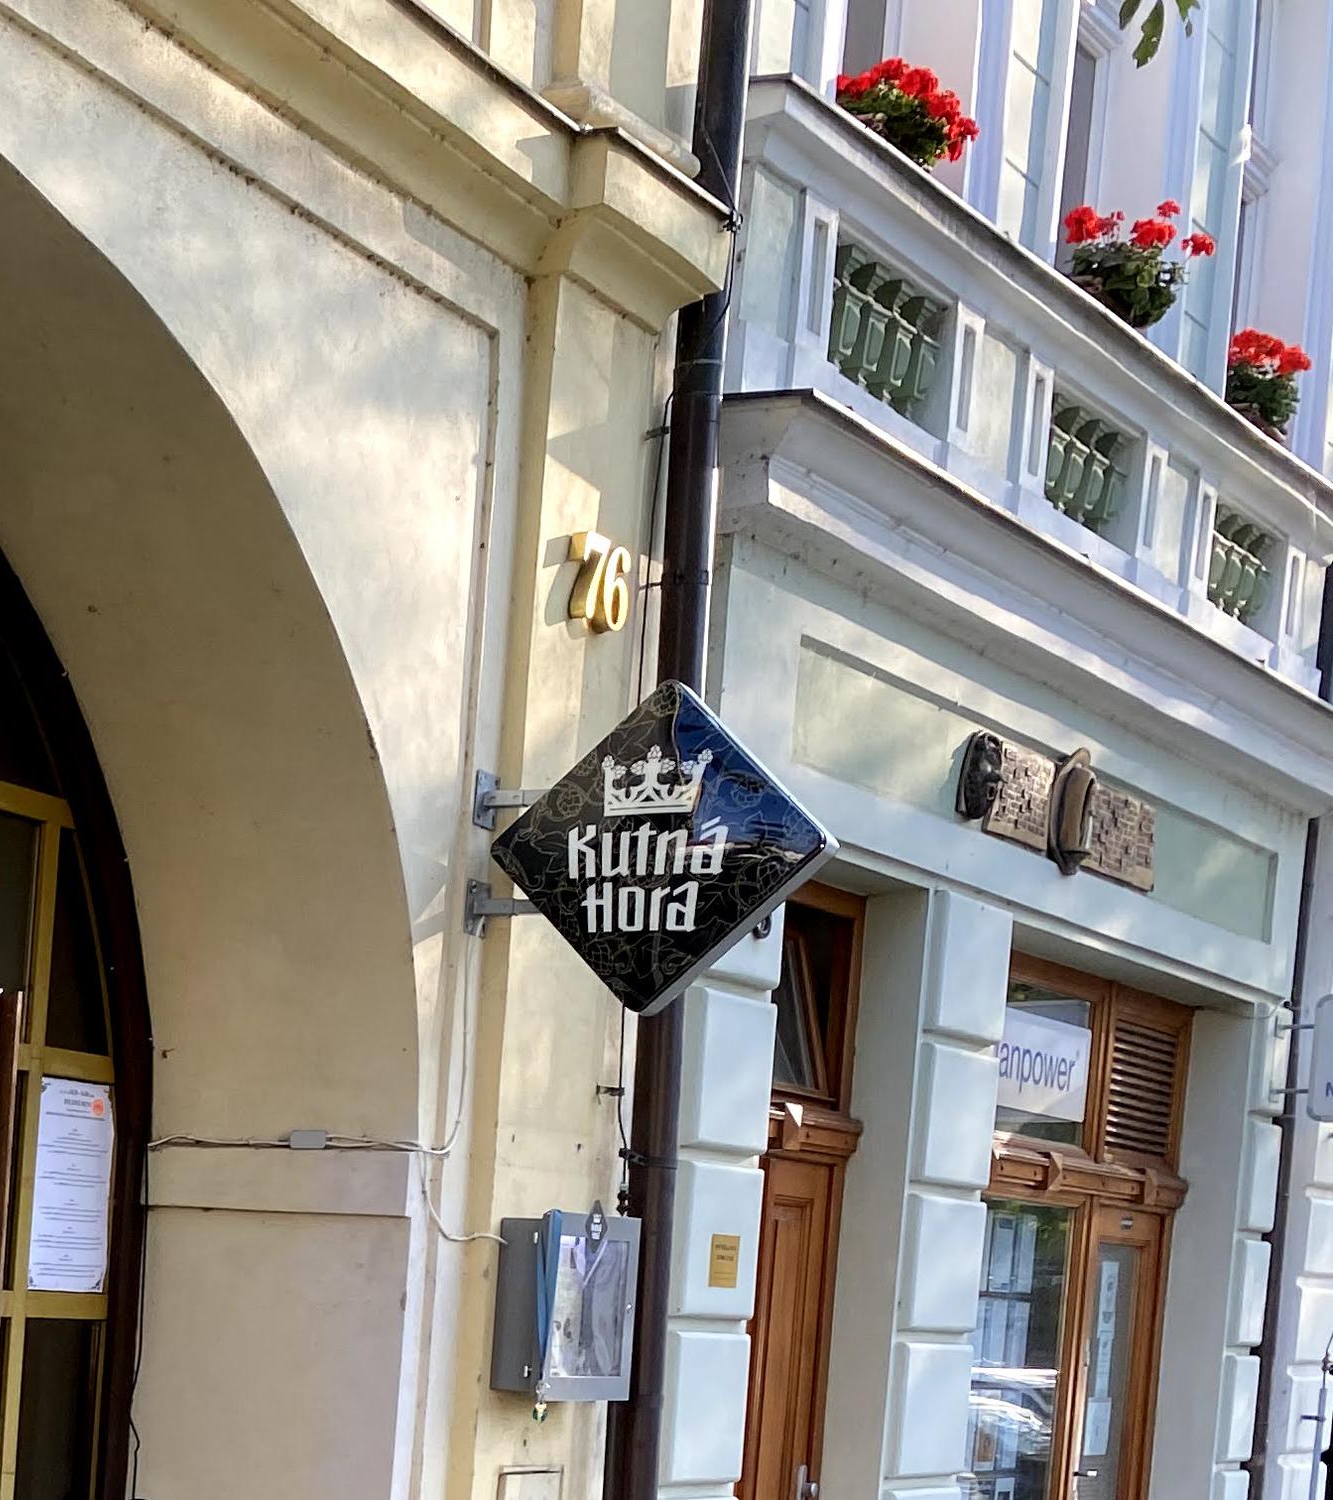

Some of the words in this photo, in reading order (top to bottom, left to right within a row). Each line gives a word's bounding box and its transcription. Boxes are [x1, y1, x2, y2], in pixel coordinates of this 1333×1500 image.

[569, 530, 632, 633] 76
[567, 816, 729, 880] Kutná
[581, 881, 699, 934] Hora
[995, 1041, 1076, 1094] anpower
